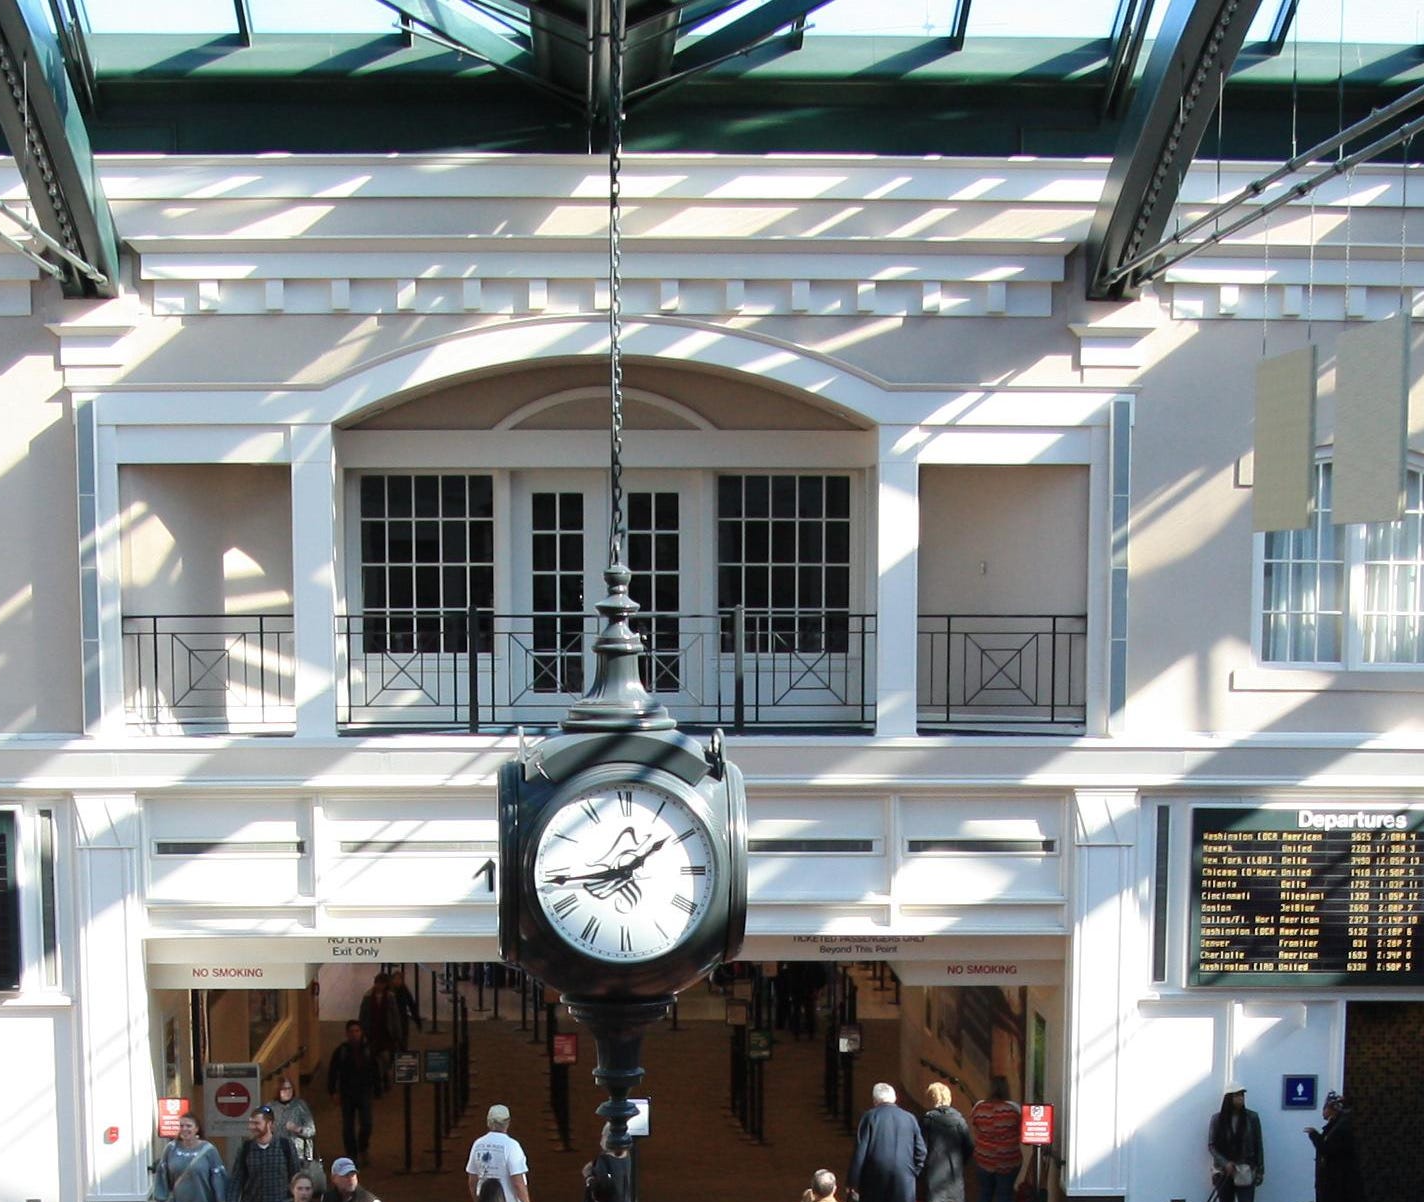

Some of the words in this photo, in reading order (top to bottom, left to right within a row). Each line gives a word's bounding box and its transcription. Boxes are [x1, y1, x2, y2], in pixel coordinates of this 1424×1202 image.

[1298, 810, 1407, 831] Departures
[1282, 844, 1313, 853] United
[1222, 856, 1242, 864] York
[1281, 856, 1308, 864] Delta
[1202, 868, 1238, 876] Chicago
[1281, 868, 1312, 876] United
[1202, 880, 1237, 888] Atlanta
[1280, 880, 1306, 888] Delta
[1409, 881, 1418, 889] 11
[1201, 892, 1250, 901] Cincinnati
[1280, 892, 1325, 900] Allegiant
[1408, 892, 1418, 900] 12
[1201, 904, 1232, 912] Boston
[1280, 904, 1316, 912] JetBlue
[1279, 915, 1320, 924] American
[1201, 927, 1250, 936] Washington
[1279, 927, 1320, 936] American
[1200, 939, 1230, 947] Denver
[1279, 939, 1319, 948] Frontier
[1406, 940, 1412, 948] 2
[332, 946, 352, 956] Exit
[356, 946, 380, 957] Only
[819, 945, 852, 954] Beyond
[855, 945, 873, 953] This
[876, 945, 898, 953] Point
[1200, 951, 1245, 959] Charlotte
[1278, 951, 1318, 960] American
[947, 965, 963, 975] NO
[967, 965, 1017, 975] SMOKING
[1200, 963, 1249, 971] Washington
[1278, 963, 1309, 971] United
[192, 968, 208, 978] NO
[212, 968, 263, 978] SMOKING
